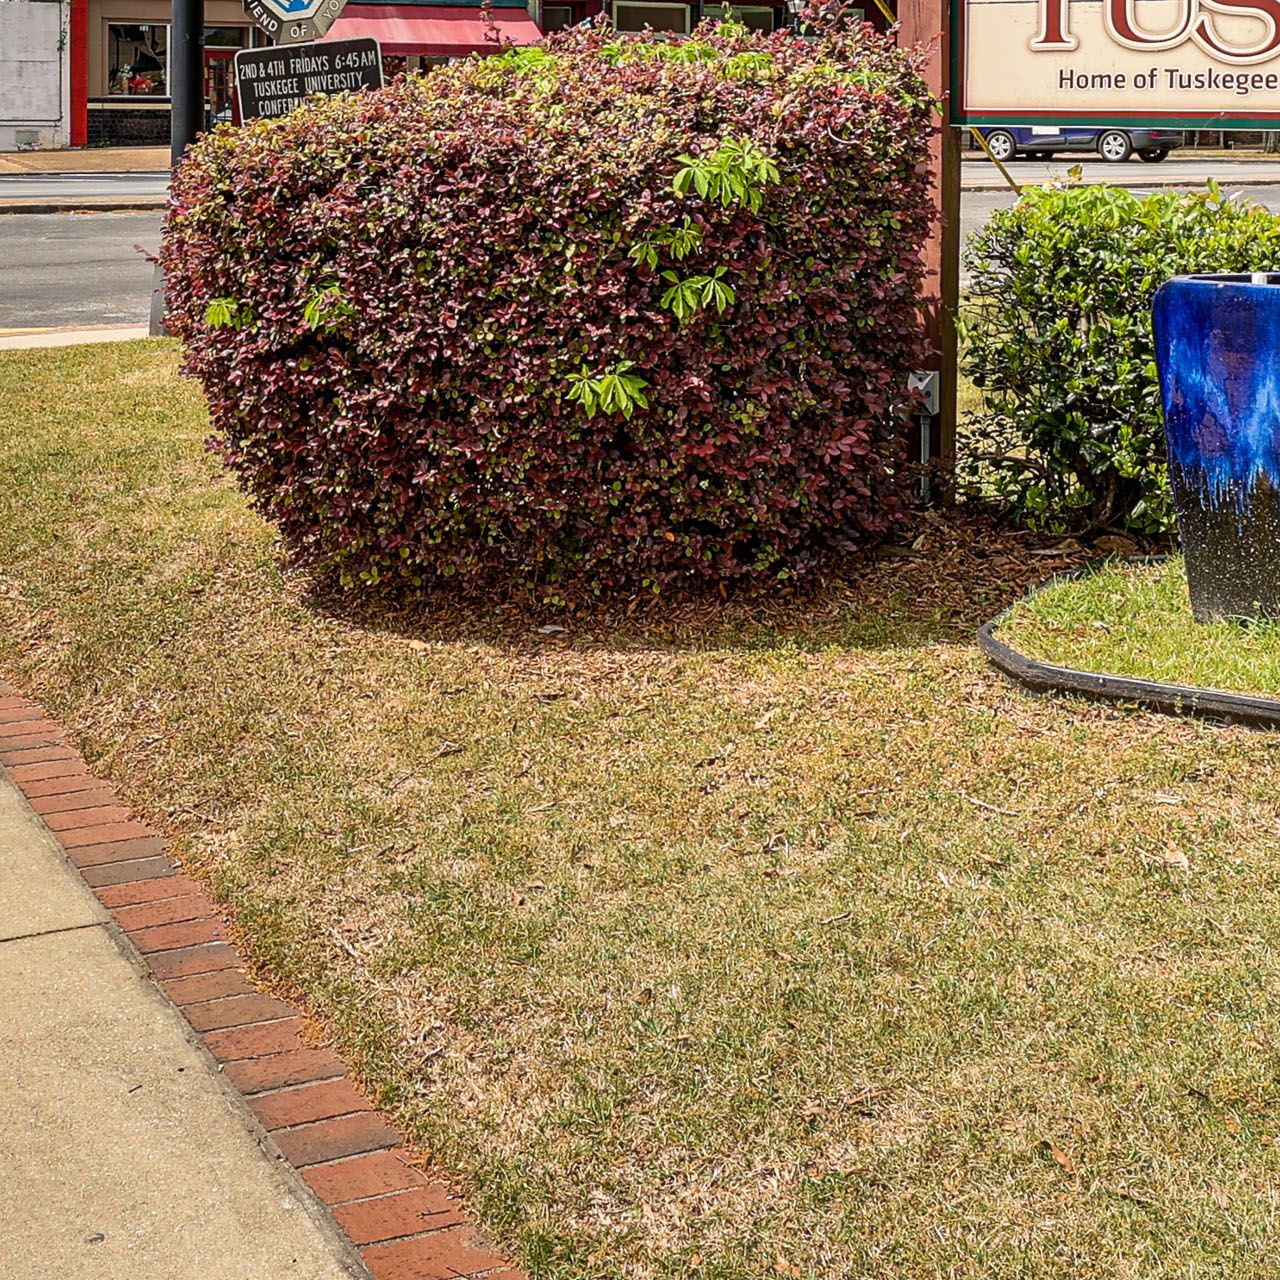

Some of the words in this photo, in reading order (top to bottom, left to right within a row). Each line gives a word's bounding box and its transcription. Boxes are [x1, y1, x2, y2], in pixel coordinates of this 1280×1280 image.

[289, 24, 309, 39] OF
[239, 63, 258, 80] 2ND
[259, 63, 266, 78] &
[267, 60, 286, 77] 4TH
[290, 55, 330, 74] FRIDAYS
[252, 78, 300, 98] TUSKEGEE
[304, 71, 363, 92] UNIVERSITY
[1058, 68, 1126, 90] Home
[1133, 67, 1159, 90] of
[1164, 68, 1279, 96] Tuskegee
